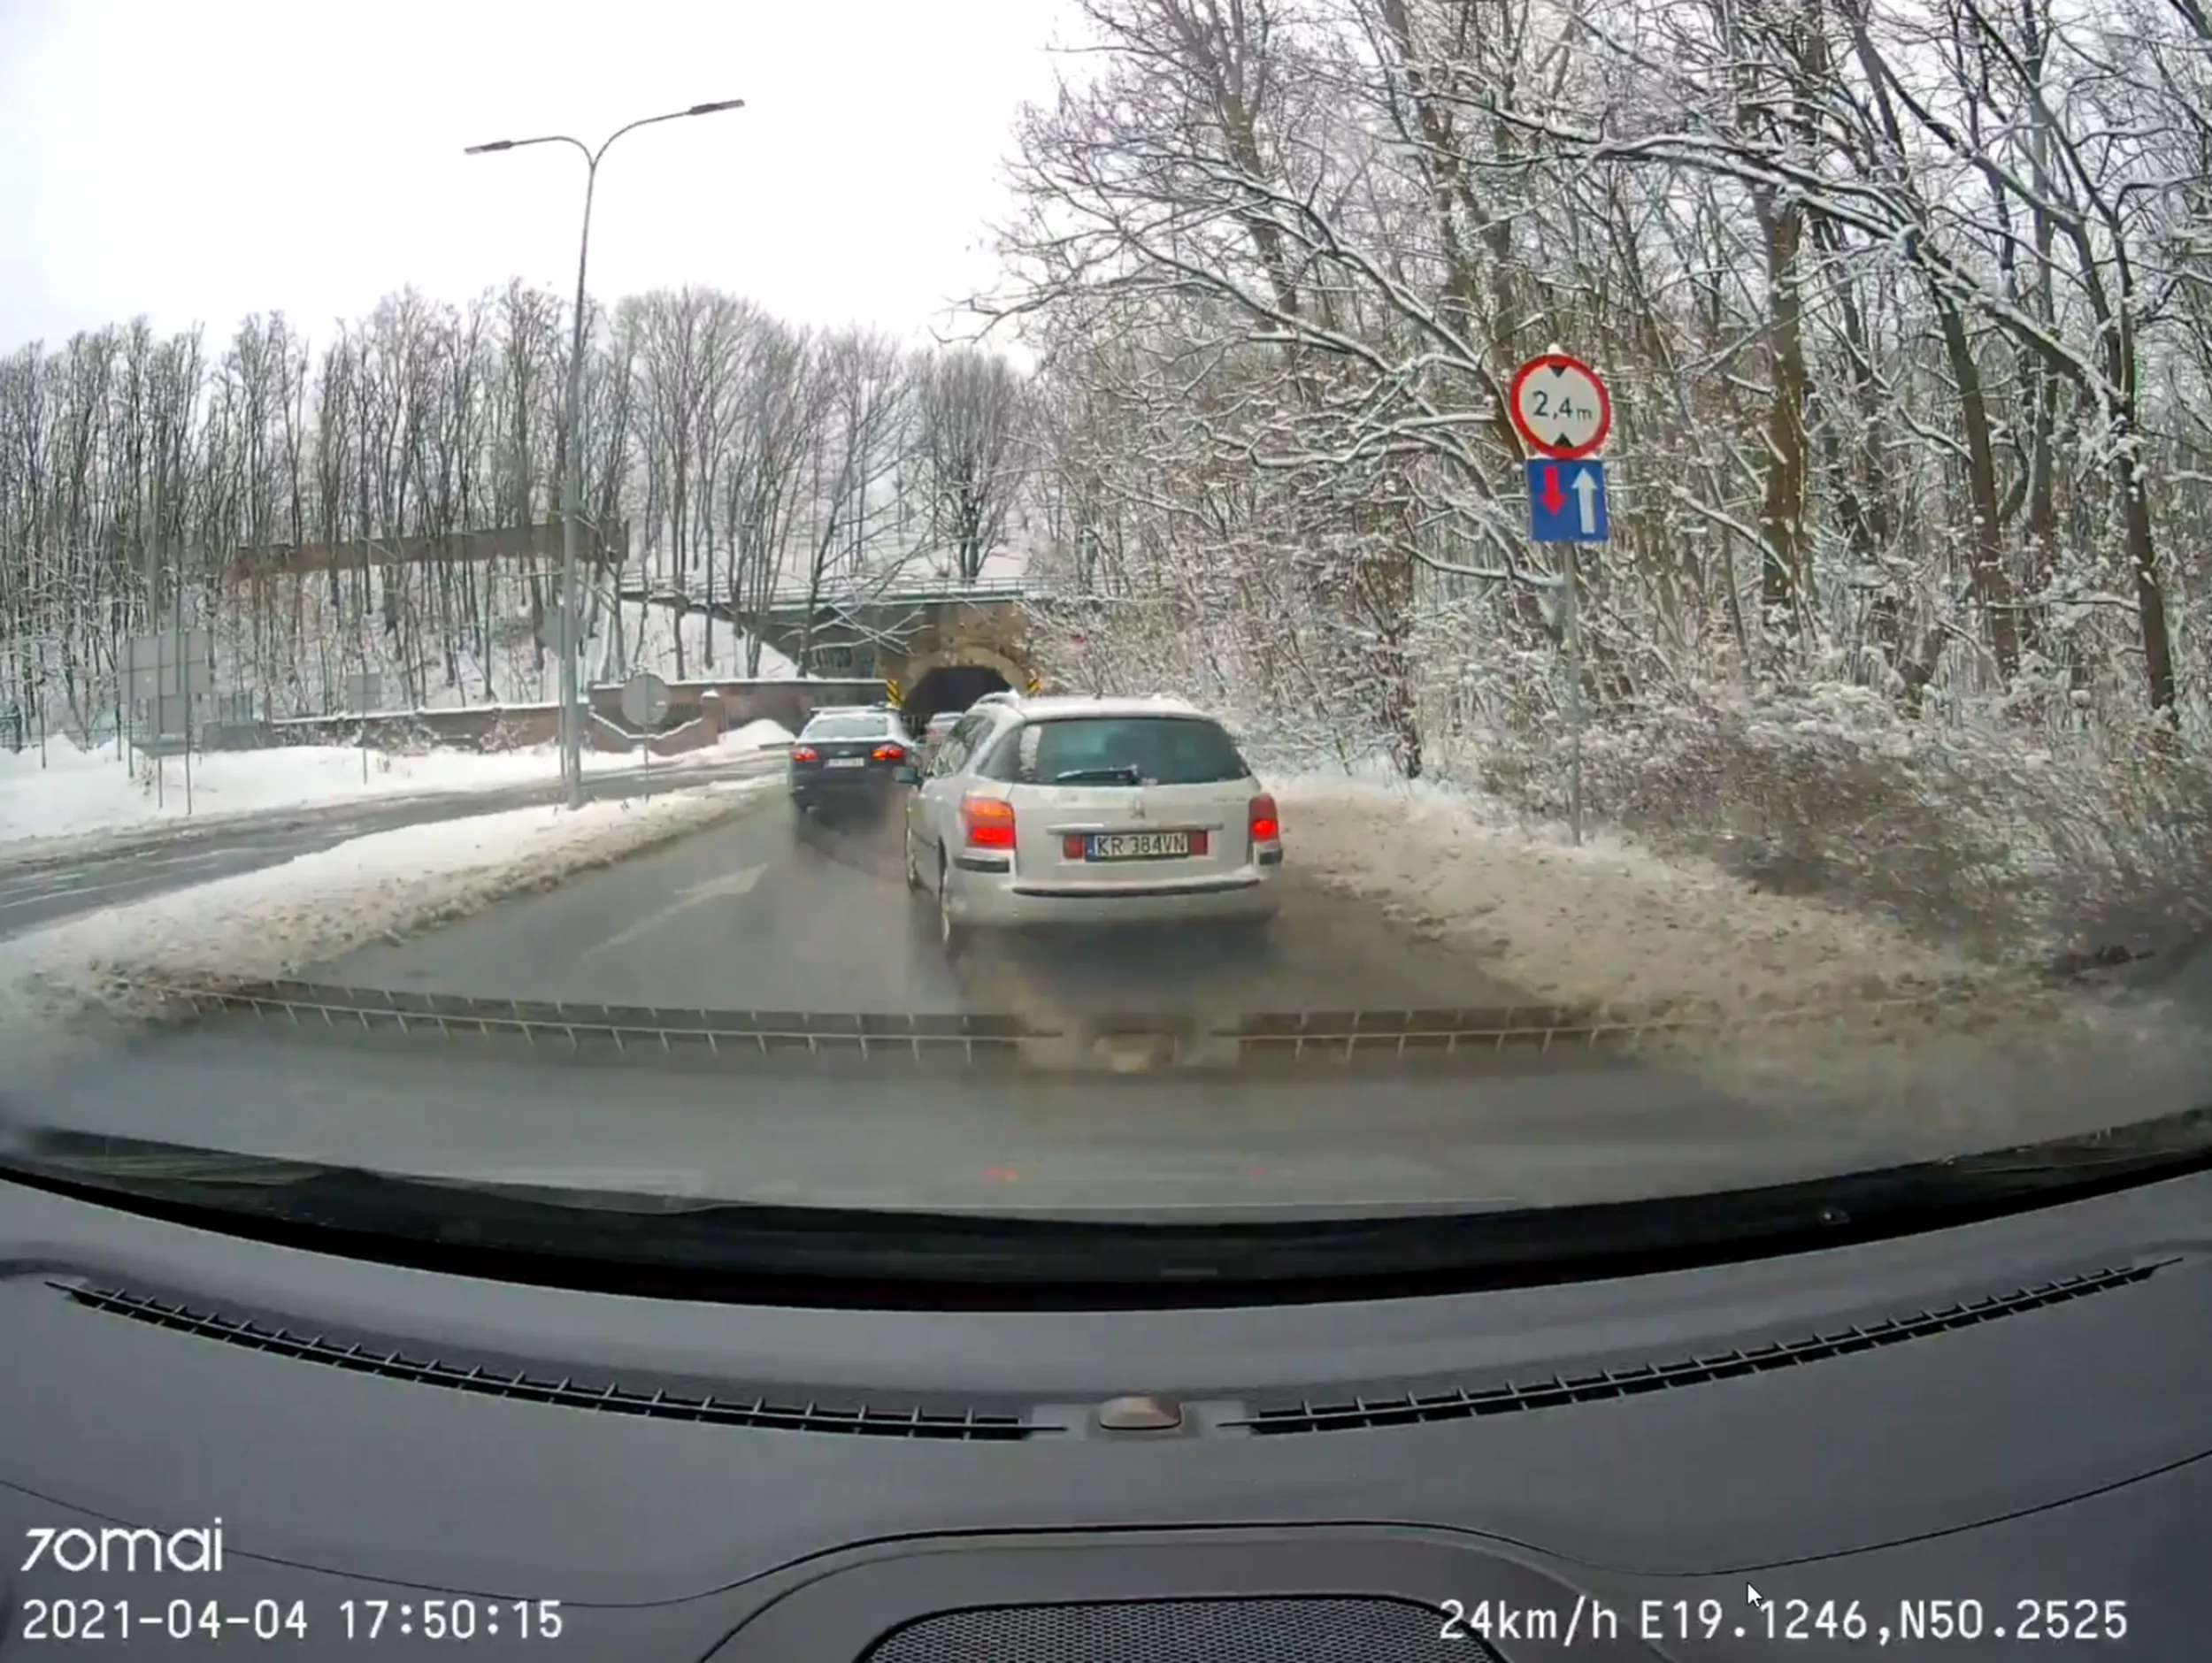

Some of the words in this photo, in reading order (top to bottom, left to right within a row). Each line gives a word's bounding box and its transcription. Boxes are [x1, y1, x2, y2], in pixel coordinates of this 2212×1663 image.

[1532, 390, 1572, 420] 2,4
[1576, 407, 1593, 422] m
[1097, 837, 1123, 855] KR
